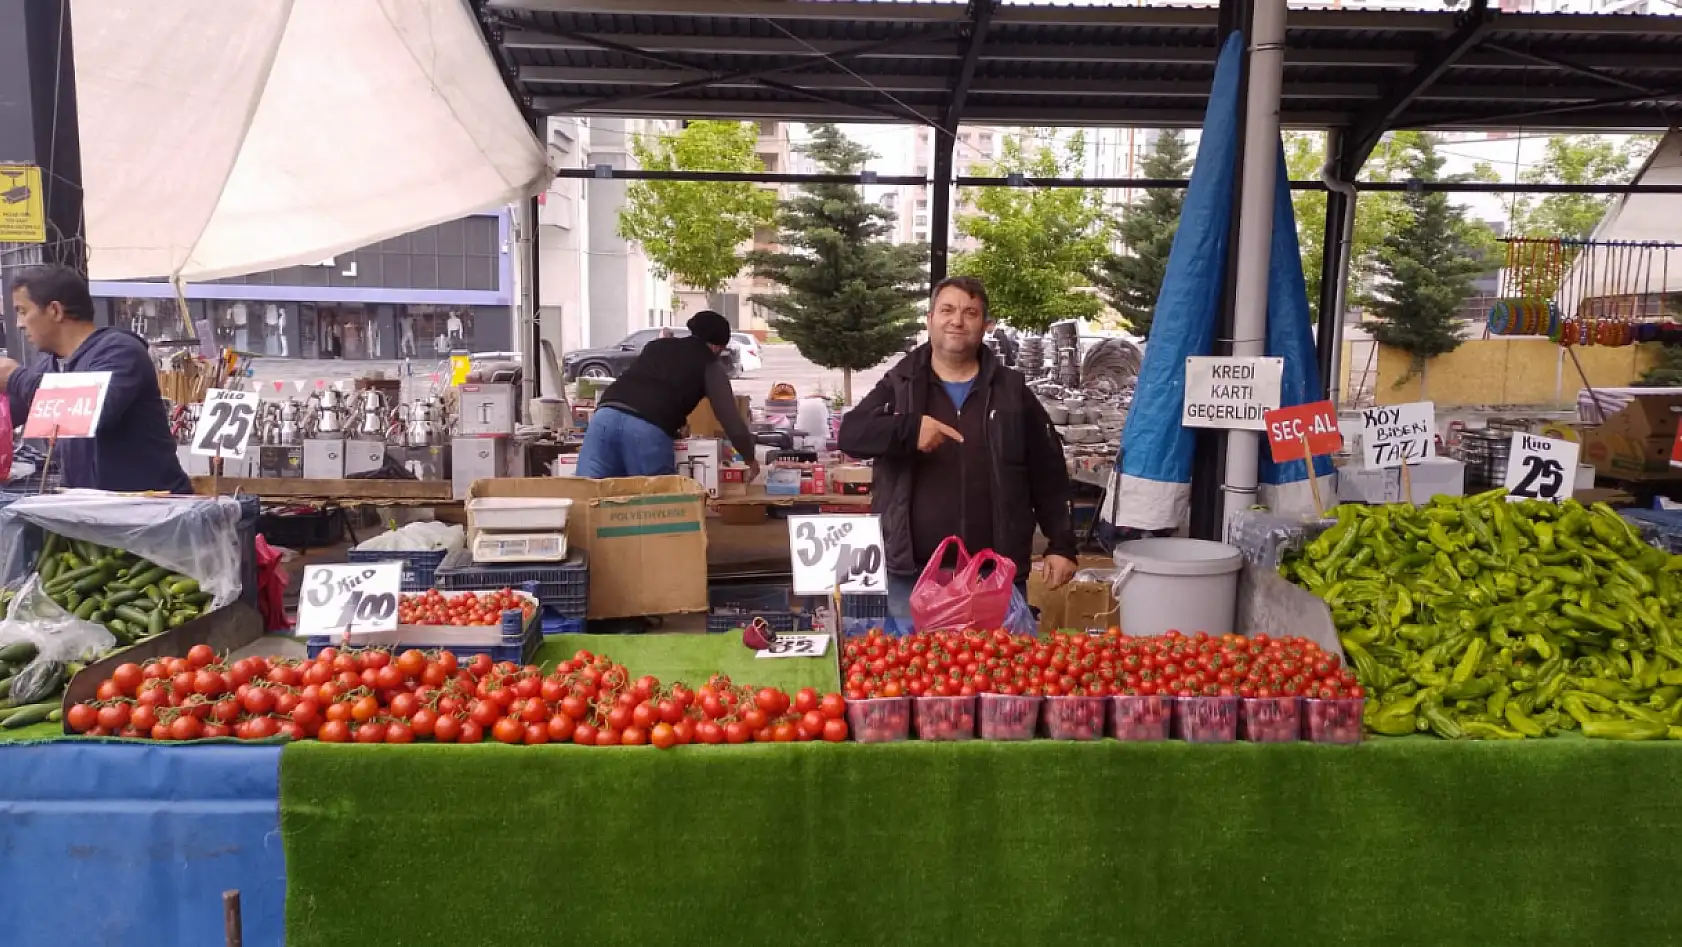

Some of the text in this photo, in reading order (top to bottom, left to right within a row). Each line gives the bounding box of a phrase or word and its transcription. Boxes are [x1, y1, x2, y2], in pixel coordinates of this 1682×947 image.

[1211, 363, 1255, 379] KREDİ
[1210, 384, 1254, 400] KARTI
[198, 401, 254, 450] 25
[1271, 417, 1305, 444] SEÇ
[1510, 455, 1564, 498] 25
[796, 521, 824, 567] 3
[827, 543, 881, 586] 100
[306, 568, 335, 607] 3
[327, 590, 396, 627] 100
